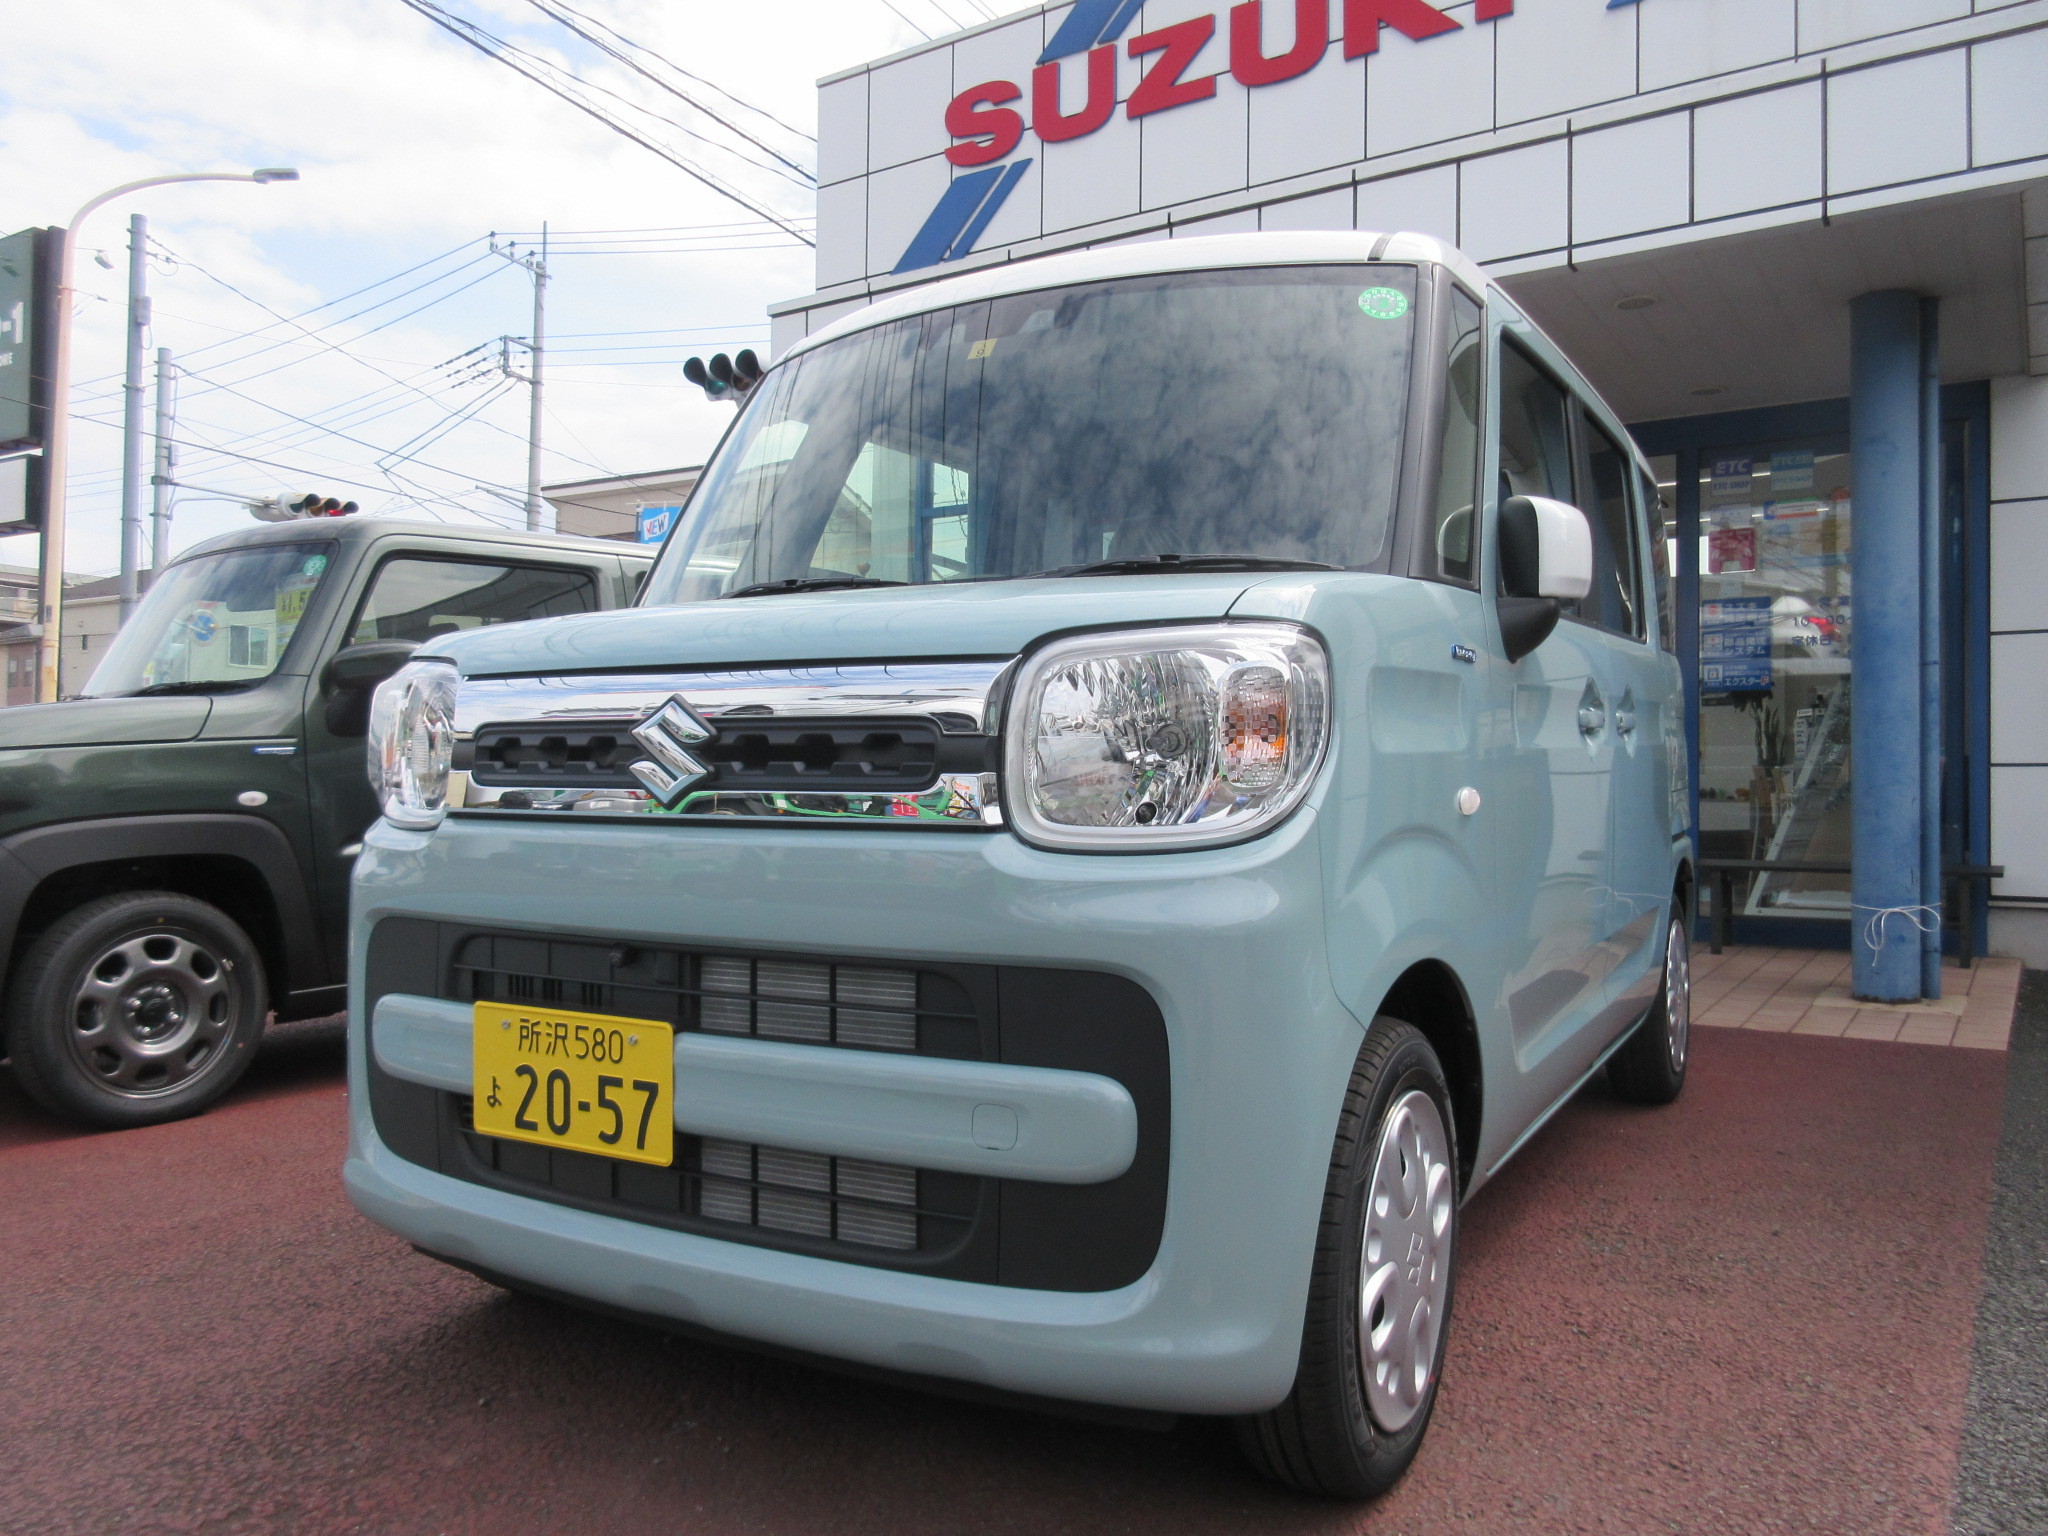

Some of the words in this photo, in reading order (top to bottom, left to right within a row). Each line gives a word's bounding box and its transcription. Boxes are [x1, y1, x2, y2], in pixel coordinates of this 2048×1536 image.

[944, 0, 1513, 168] SUZUK
[1715, 459, 1750, 474] ETC
[1791, 634, 1832, 647] 定休日
[486, 1075, 502, 1108] よ
[514, 1063, 660, 1150] 20-57
